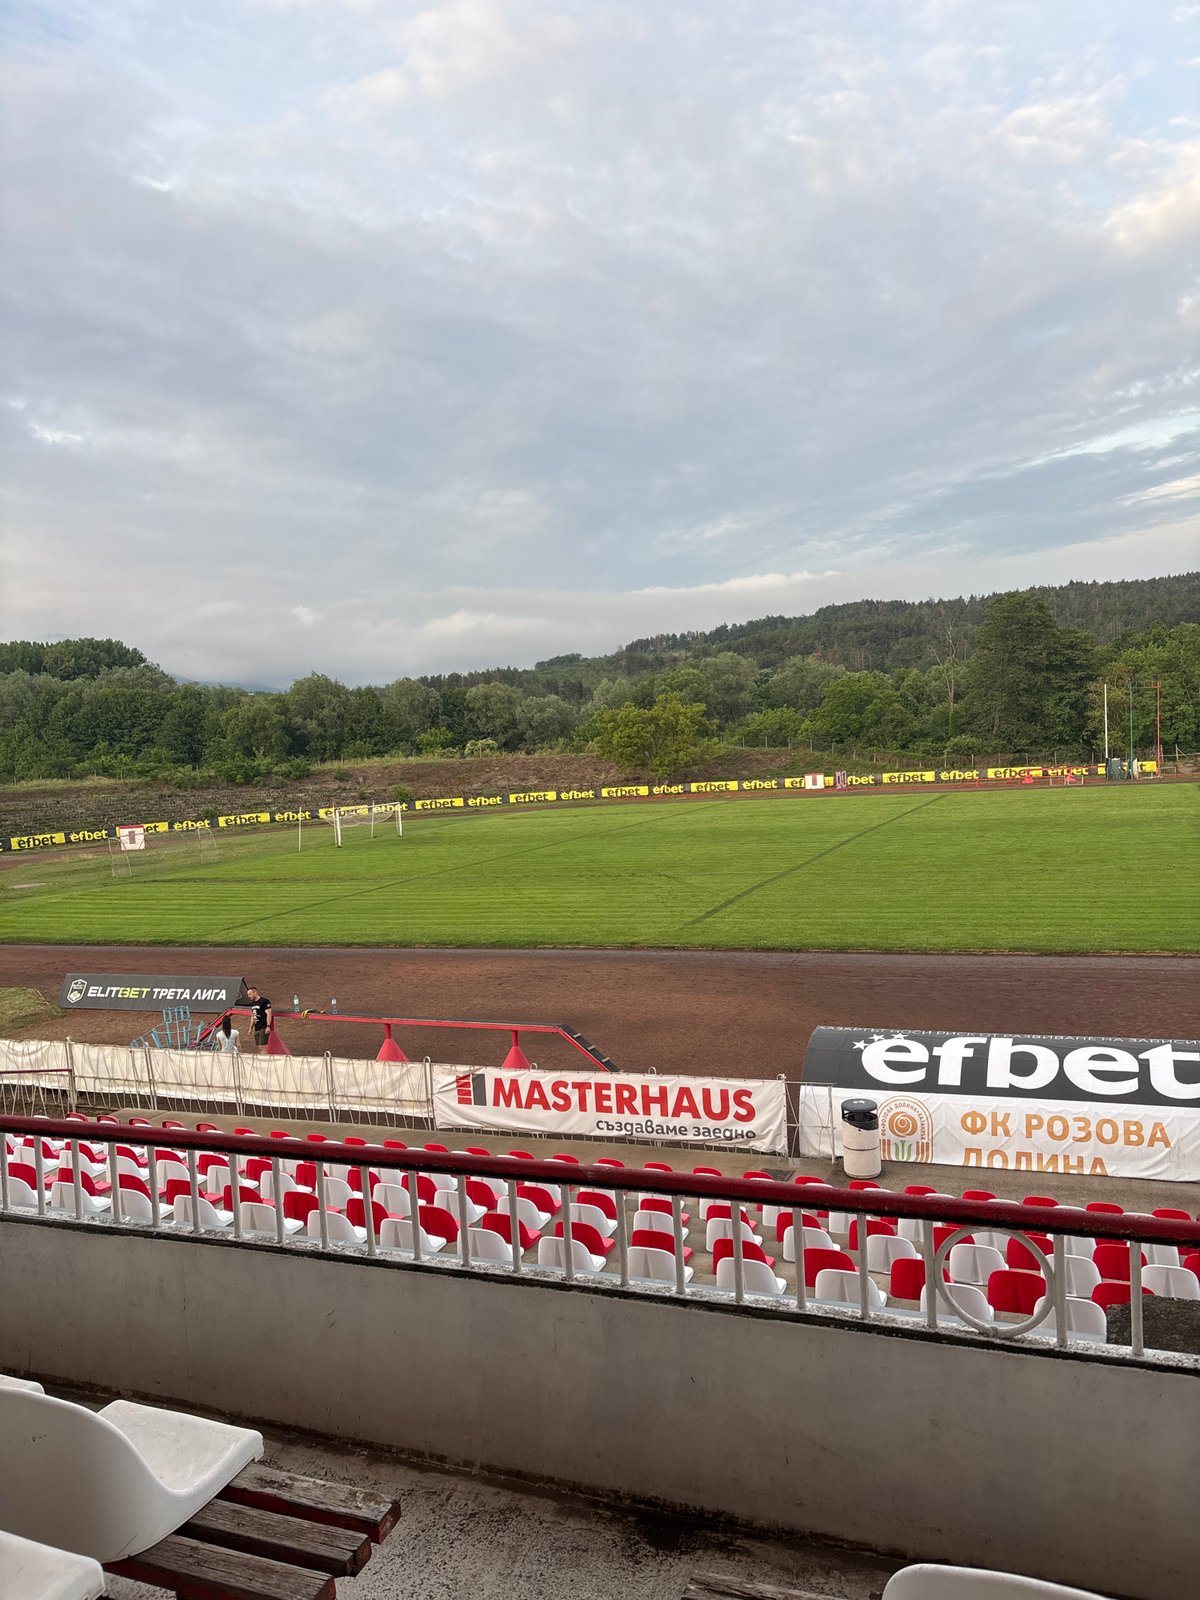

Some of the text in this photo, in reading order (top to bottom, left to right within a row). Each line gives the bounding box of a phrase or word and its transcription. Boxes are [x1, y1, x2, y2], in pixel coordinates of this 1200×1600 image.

[888, 773, 925, 783] efbet
[940, 770, 979, 780] efbet
[994, 769, 1030, 778] efbe
[742, 779, 777, 790] efbet
[847, 774, 875, 785] fbet
[607, 787, 641, 797] efbet
[652, 784, 684, 794] efbet
[696, 782, 729, 792] efbet
[515, 793, 549, 803] efbet
[560, 790, 594, 800] efbet
[421, 799, 455, 809] efbet
[467, 796, 502, 807] efbet
[225, 814, 261, 826] efbet
[275, 810, 311, 822] efbet
[173, 819, 211, 831] efbet
[70, 829, 108, 842] efbet
[17, 835, 56, 849] efbet
[87, 986, 151, 998] ELITBET
[152, 988, 191, 1000] ТРЕТА
[191, 988, 226, 1001] ЛИГА
[861, 1036, 1200, 1100] efbet
[493, 1078, 756, 1123] MASTERHAUS
[596, 1119, 756, 1141] създаваме заедно
[960, 1110, 1173, 1149] ФК РОЗОВА
